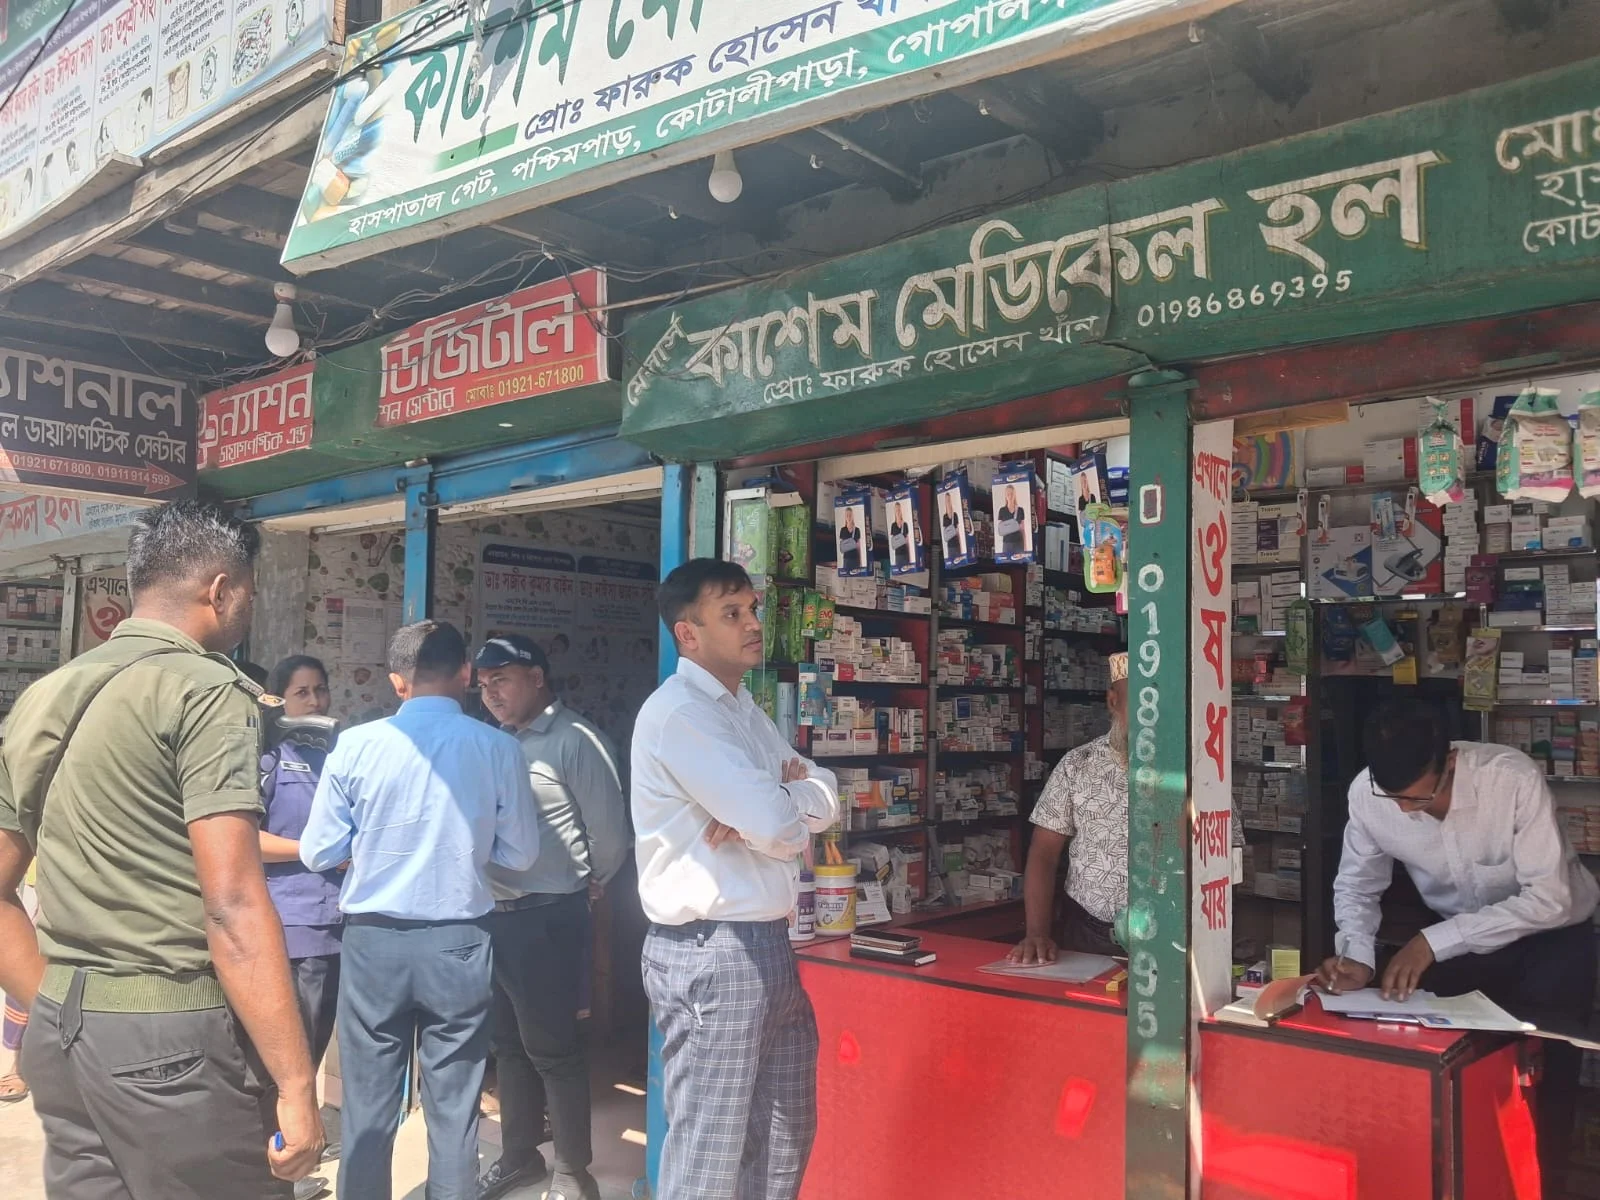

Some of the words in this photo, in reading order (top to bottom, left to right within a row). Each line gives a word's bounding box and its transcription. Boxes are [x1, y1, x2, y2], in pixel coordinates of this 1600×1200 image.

[592, 54, 696, 113] ফারুক
[708, 0, 842, 74] হোসেন
[349, 192, 445, 237] হাসপাতাল
[452, 168, 498, 205] গেট,
[656, 46, 868, 139] কোটালীপাড়া,
[684, 289, 880, 388] কাশেম
[894, 197, 1226, 350] মেডিকেল
[1246, 150, 1446, 275] হল
[1137, 268, 1353, 328] 01986869395
[498, 364, 584, 397] 01921-671800
[819, 355, 915, 390] ফারুক
[923, 331, 1032, 372] হোসেন
[219, 372, 314, 437] ন্যাশন
[406, 386, 456, 418] সেন্টার
[135, 430, 187, 465] সেন্টার
[1194, 451, 1231, 500] এখানে
[1192, 809, 1230, 862] পাওয়া
[1200, 876, 1230, 931] যায়
